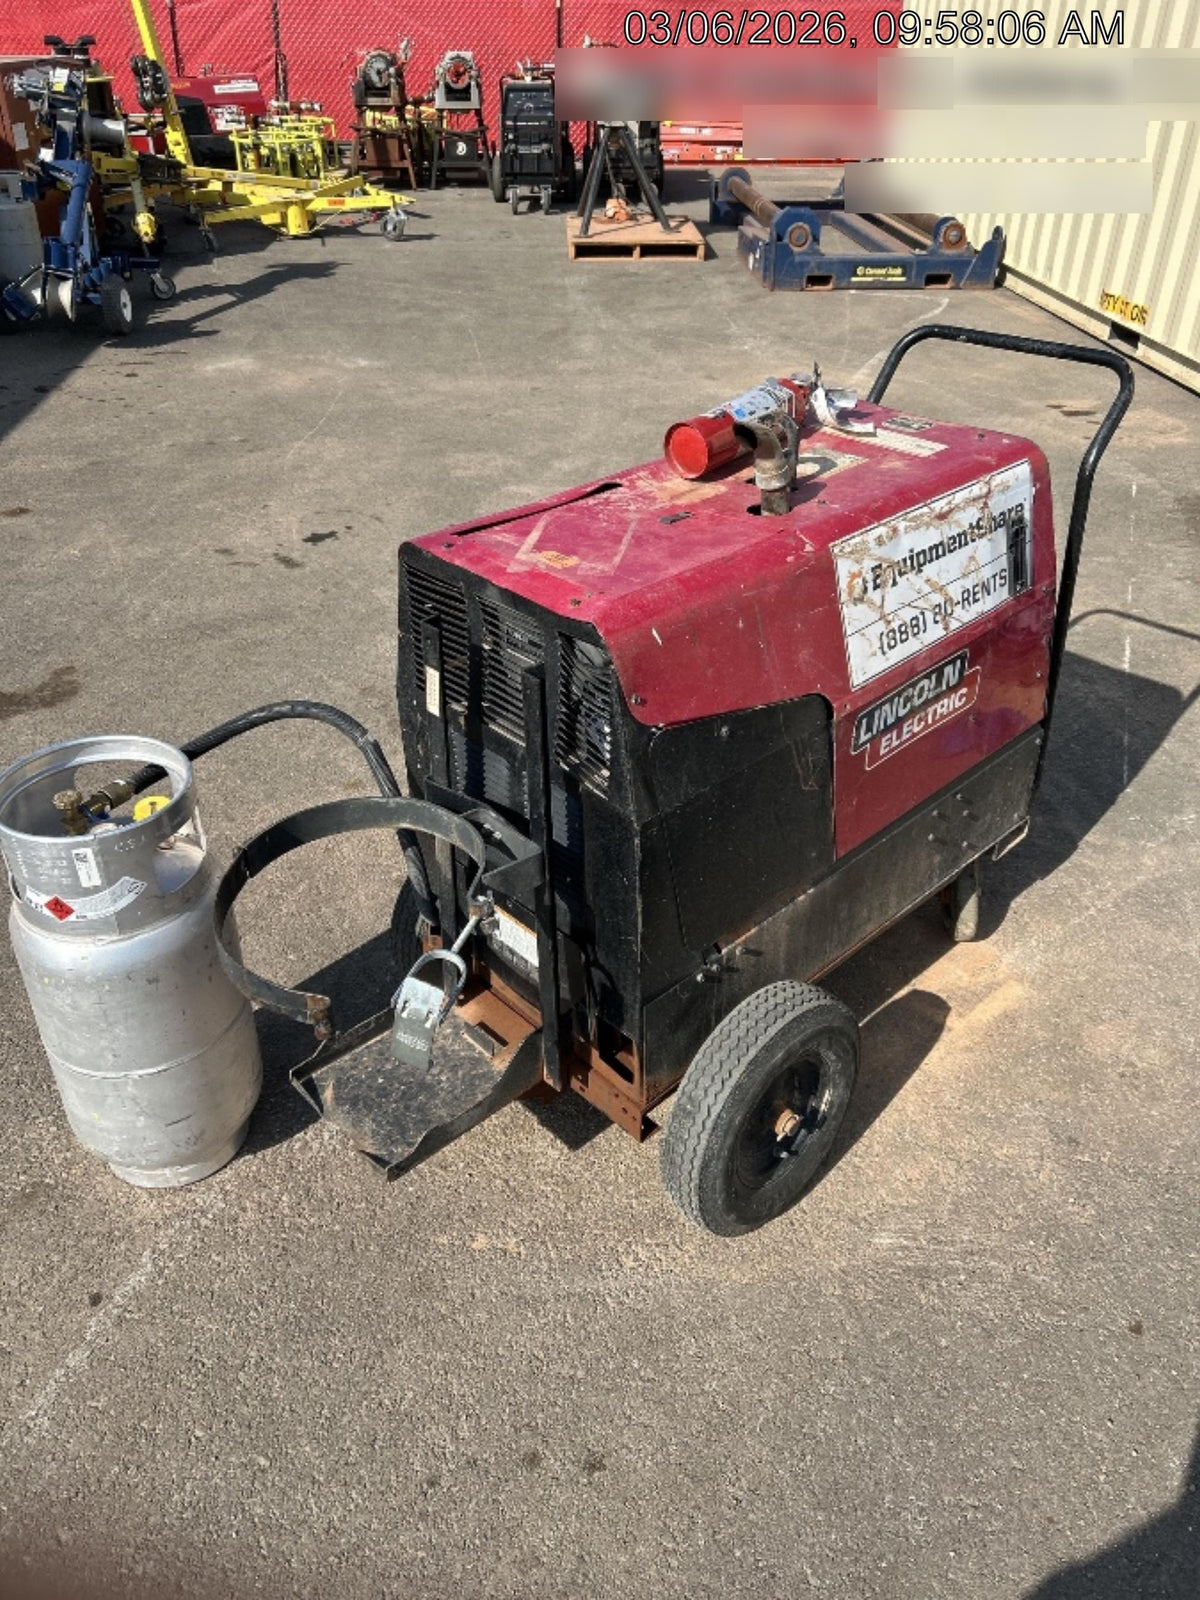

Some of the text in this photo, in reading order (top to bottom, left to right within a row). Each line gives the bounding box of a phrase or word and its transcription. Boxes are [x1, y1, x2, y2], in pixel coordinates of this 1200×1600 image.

[878, 611, 928, 655] (888)
[858, 659, 961, 745] LINCOLN
[879, 687, 968, 756] ELECTRIC
